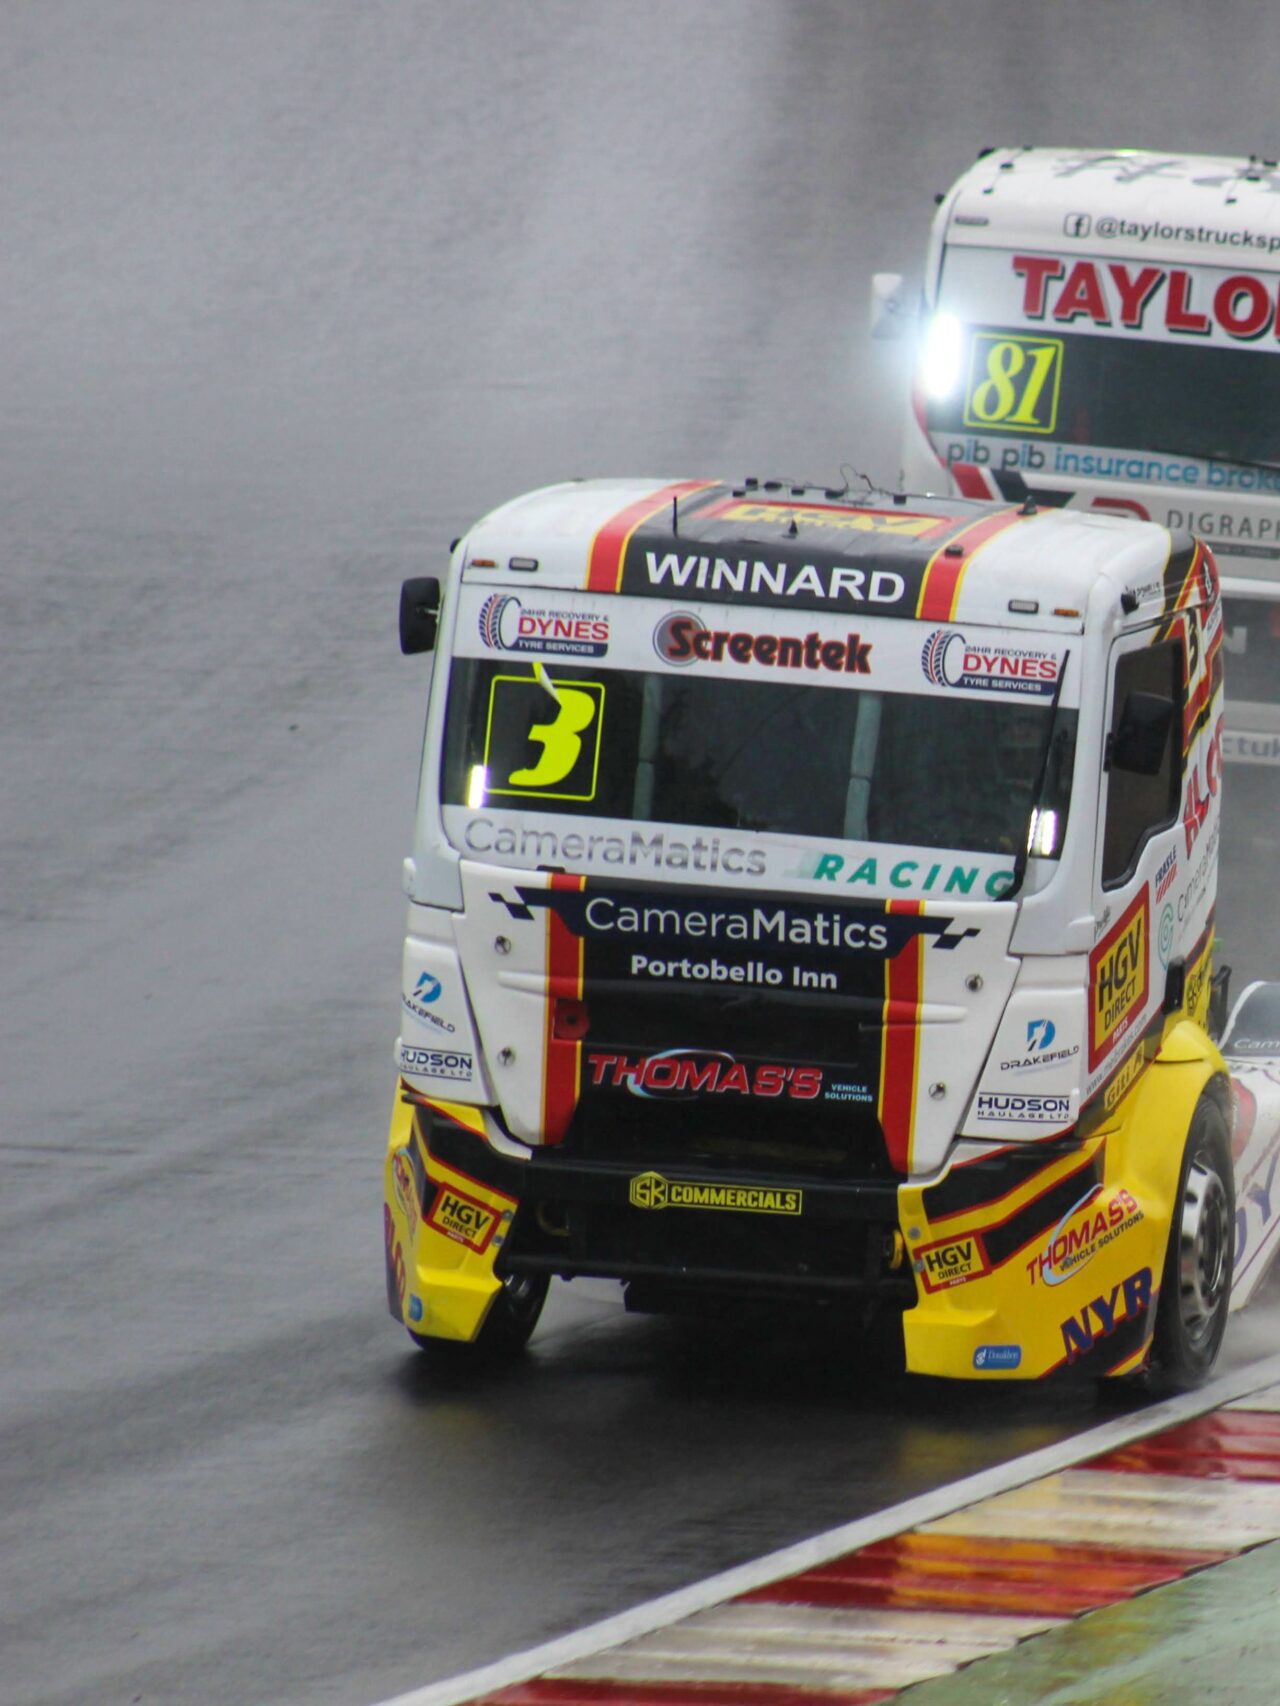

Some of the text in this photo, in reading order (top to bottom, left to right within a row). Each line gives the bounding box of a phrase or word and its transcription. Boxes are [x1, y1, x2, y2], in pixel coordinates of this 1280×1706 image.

[972, 341, 1058, 425] 81
[947, 441, 990, 468] pib
[1001, 444, 1046, 472] pib
[1054, 447, 1198, 486] insurance
[646, 551, 905, 603] WINNARD
[518, 617, 609, 641] DYNES
[549, 610, 601, 622] RECOVERY
[519, 639, 595, 654] TYRE SERVICES
[667, 618, 874, 675] Screentek
[965, 644, 992, 654] 24HR
[994, 647, 1048, 659] RECOVERY
[963, 653, 1057, 679] DYNES
[963, 676, 1042, 693] TYRE SERVICES
[508, 675, 595, 787] 3
[464, 817, 1015, 900] CameraMatics RACING
[585, 897, 888, 951] CameraMatics
[631, 954, 838, 990] Portobello Inn
[1098, 918, 1142, 1013] HGV
[1104, 976, 1136, 1032] DIRECT
[1000, 1045, 1079, 1071] DRAKEFIELD
[589, 1053, 823, 1100] THOMAS'S
[832, 1084, 868, 1093] VEHICLE
[825, 1092, 873, 1103] SOLUTIONS
[978, 1096, 1070, 1112] HUDSON
[978, 1111, 1069, 1120] HAULAGE LTD
[441, 1195, 490, 1231] HGV
[671, 1185, 797, 1211] COMMERCIALS
[442, 1215, 479, 1239] DIRECT
[1059, 1210, 1145, 1272] VEHICLE SOLUTIONS
[925, 1241, 972, 1273] HGV
[938, 1262, 972, 1281] DIRECT
[1060, 1266, 1153, 1365] NYR
